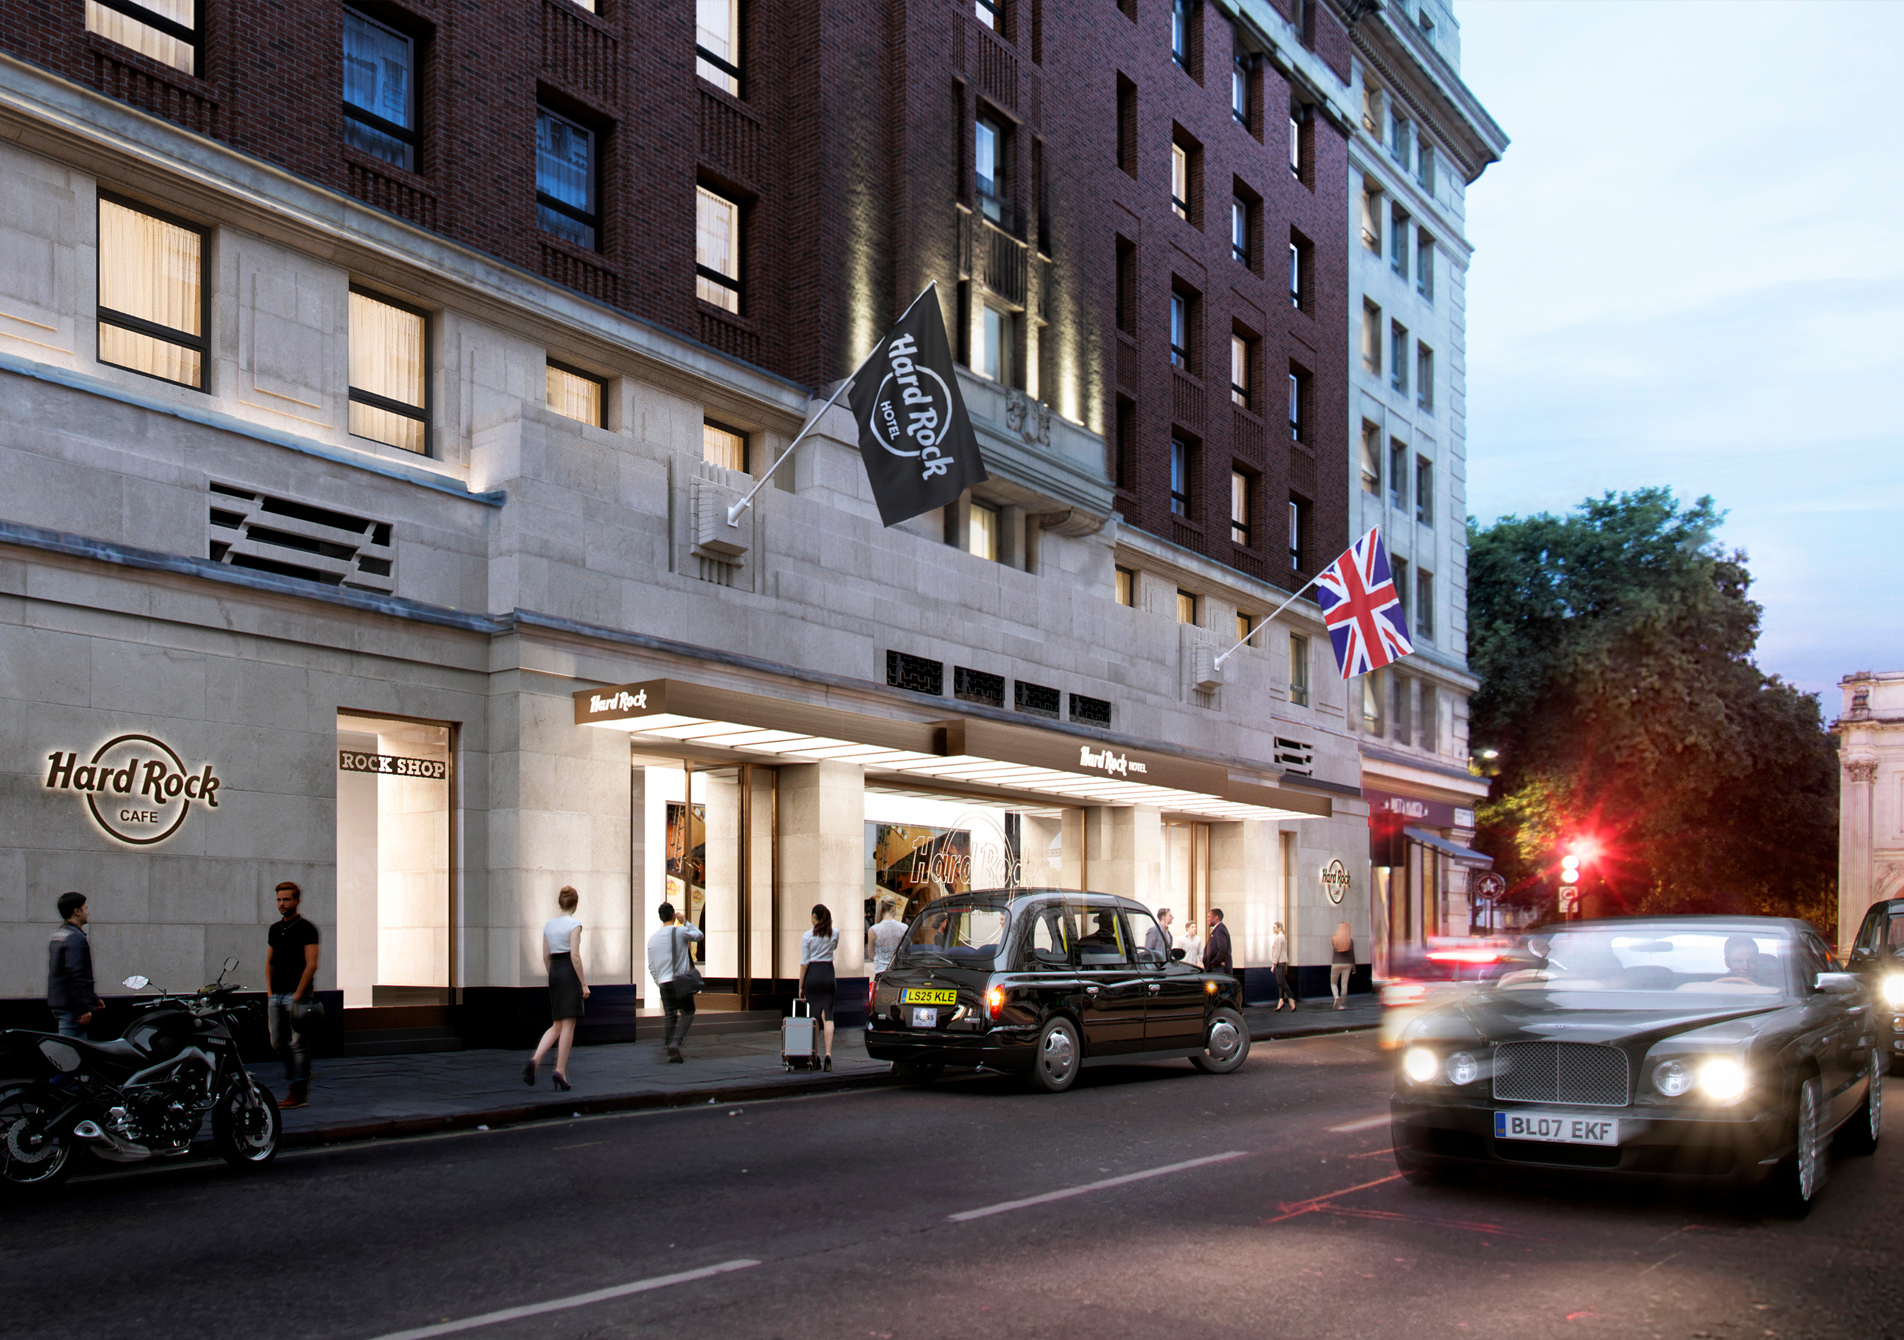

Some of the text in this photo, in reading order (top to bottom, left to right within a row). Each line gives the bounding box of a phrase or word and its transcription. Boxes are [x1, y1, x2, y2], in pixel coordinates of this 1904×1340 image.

[888, 333, 955, 481] Hard Rock
[880, 400, 901, 441] HOTEL
[590, 689, 647, 713] Hard Rock
[341, 753, 445, 778] ROCK SHOP
[1080, 746, 1147, 776] Hard Rock HOTEL
[46, 751, 221, 807] Hard Rock
[120, 809, 159, 823] CAFE
[910, 835, 1036, 896] Hard Rock
[1321, 868, 1351, 888] Hard Rock
[908, 991, 955, 1002] LS25 KLE
[207, 1037, 226, 1045] YAMAHA
[1511, 1117, 1612, 1141] BL07 EKF
